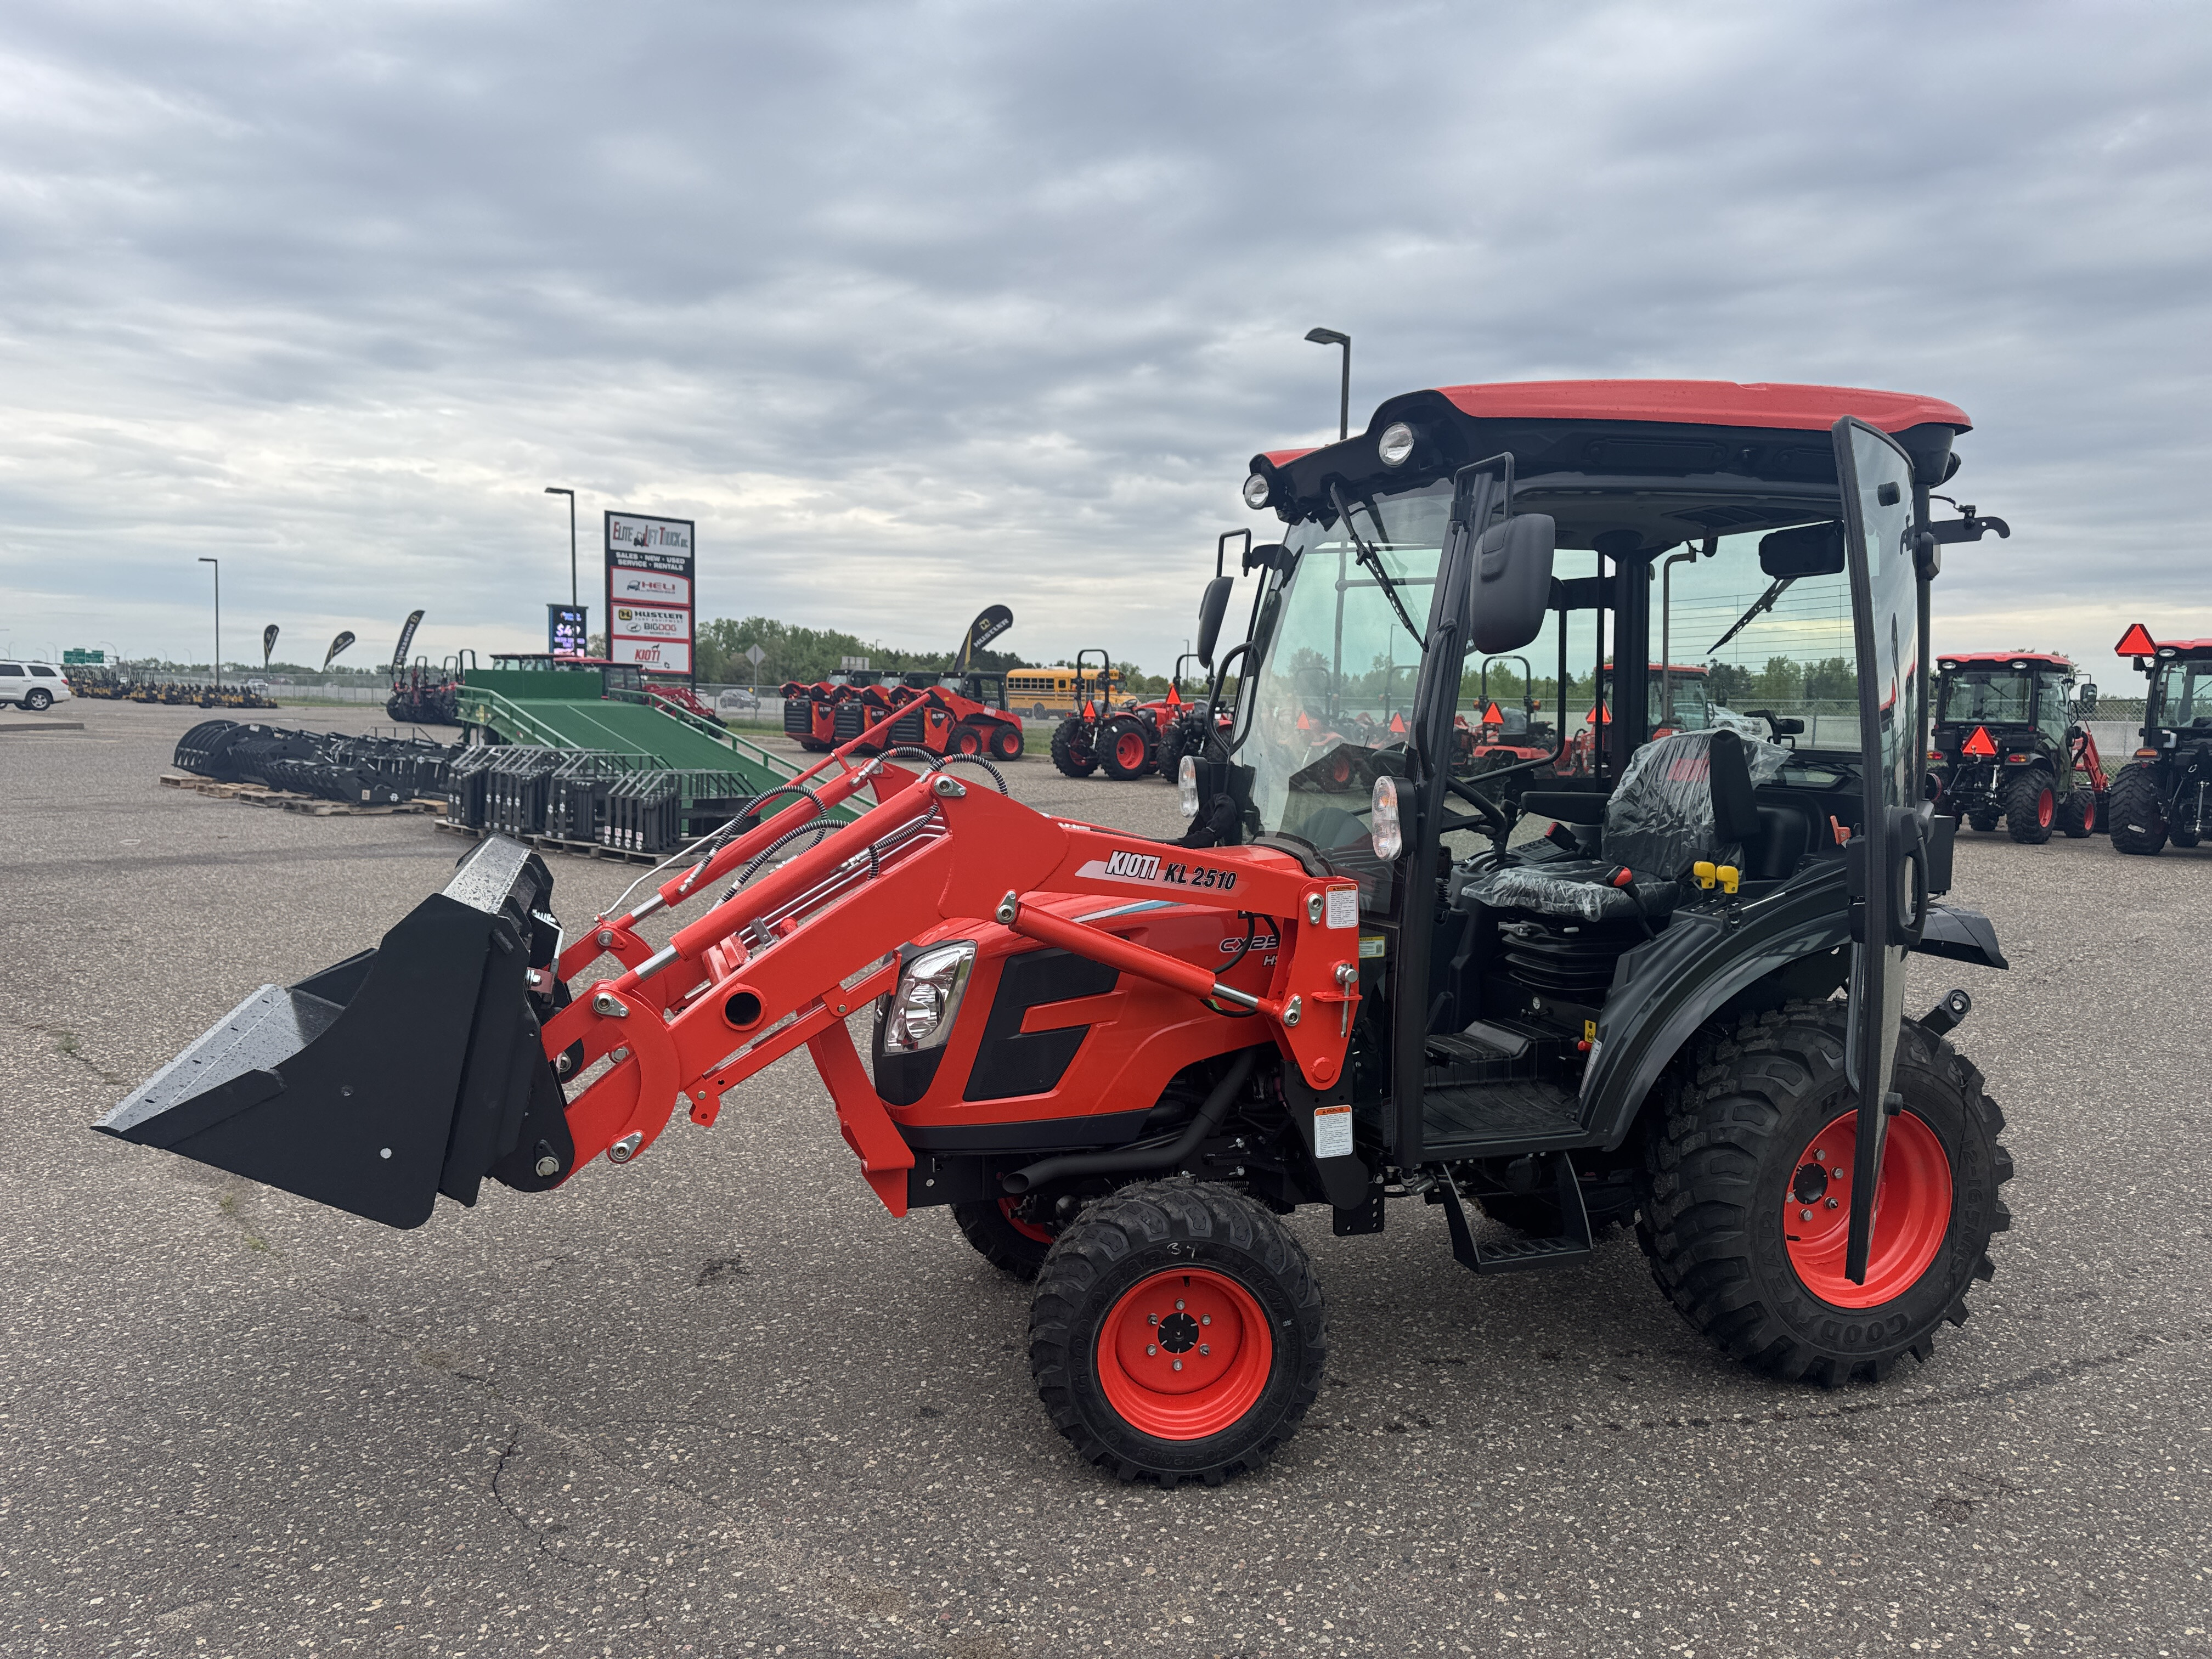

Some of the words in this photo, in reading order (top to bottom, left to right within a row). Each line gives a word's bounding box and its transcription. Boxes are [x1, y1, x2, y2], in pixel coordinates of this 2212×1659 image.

[613, 521, 633, 541] ELITE
[644, 524, 658, 548] LIFT
[616, 551, 638, 560] SALES
[618, 558, 647, 568] SERVICE
[653, 562, 684, 571] RENTALS
[642, 582, 675, 590] HELI
[635, 611, 682, 619] HUSTLER
[644, 623, 676, 632] BIGDOG
[973, 618, 1009, 647] HUSTLER
[635, 649, 661, 661] KIOTI
[1105, 850, 1162, 880] KIOTI
[1163, 862, 1188, 884] KL
[1190, 866, 1238, 891] 2510
[1759, 1210, 1909, 1345] GOODYEAR
[1073, 1250, 1165, 1395] GOODYEAR
